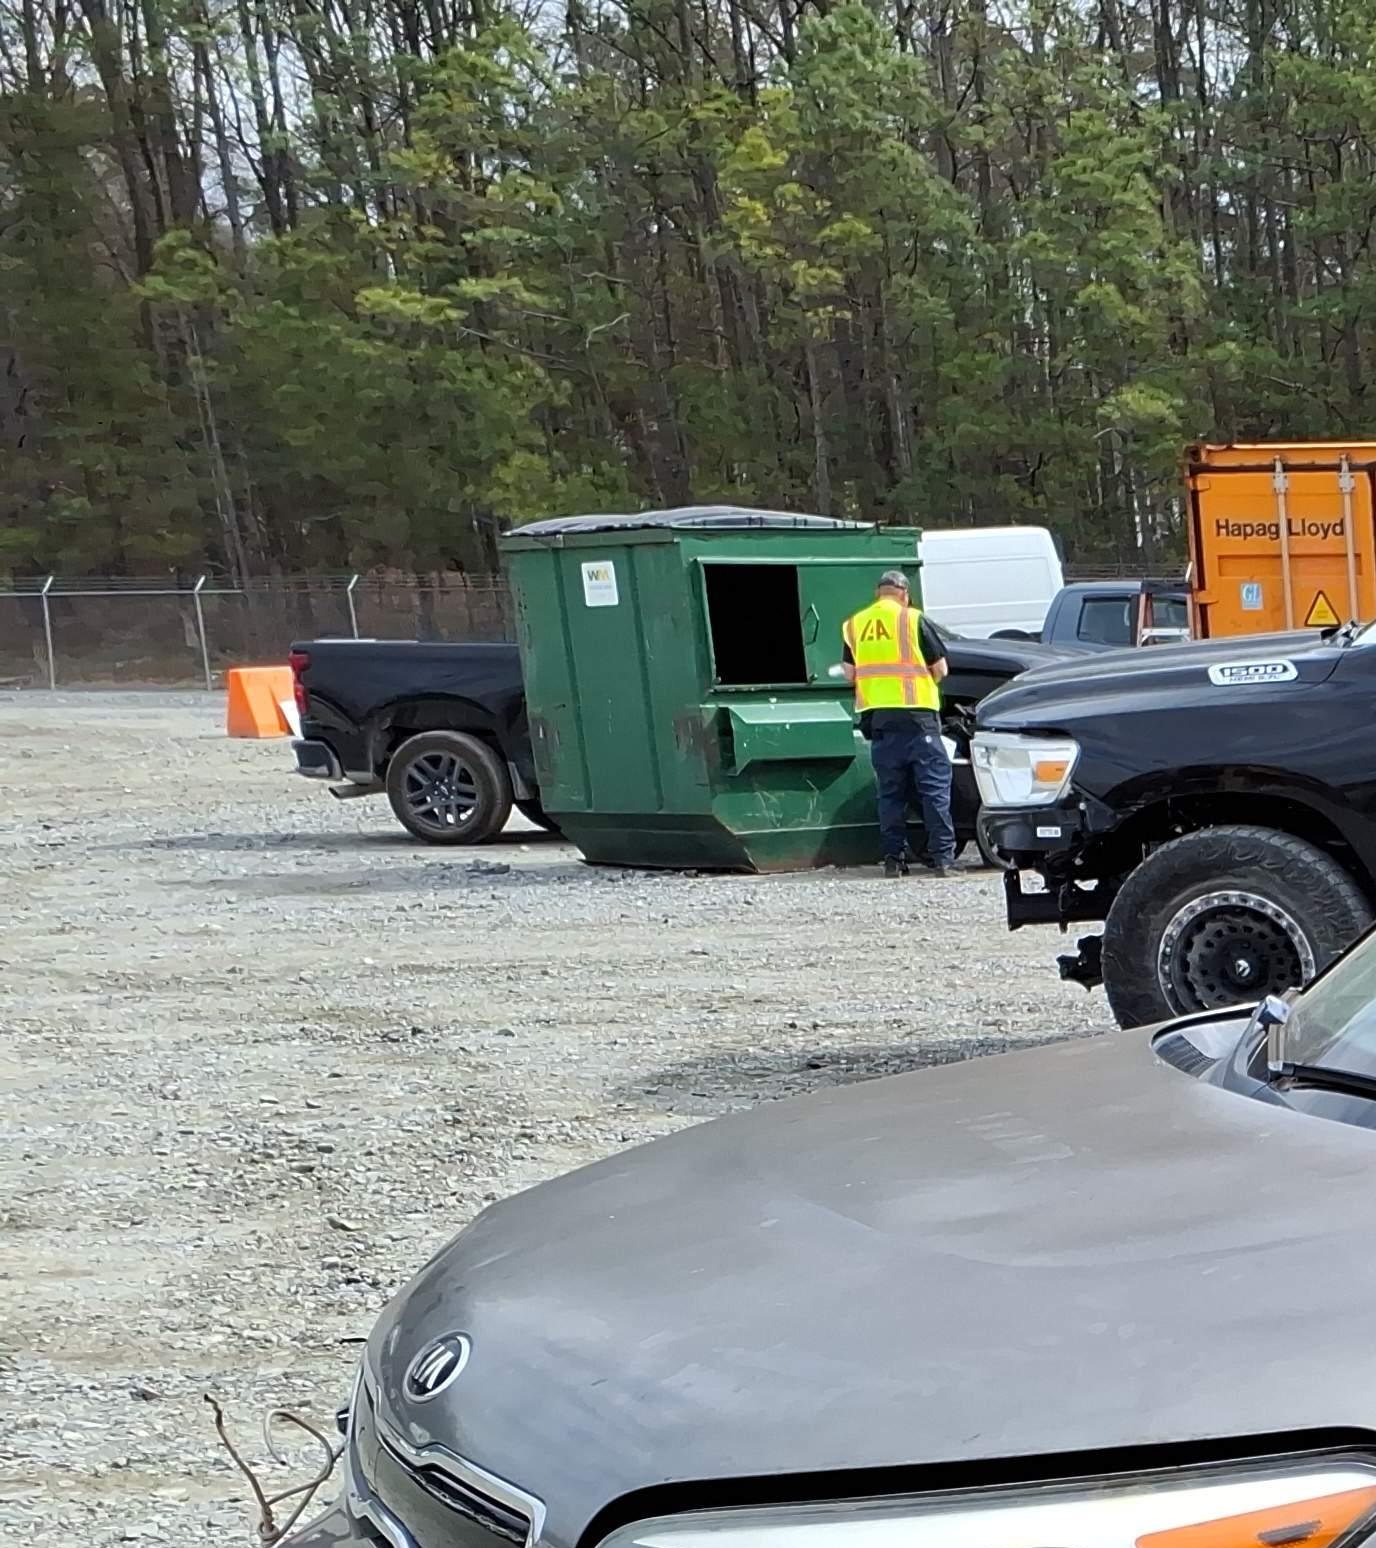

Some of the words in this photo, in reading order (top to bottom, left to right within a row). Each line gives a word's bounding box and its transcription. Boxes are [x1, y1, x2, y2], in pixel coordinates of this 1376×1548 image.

[1215, 518, 1280, 540] Hapag
[1288, 518, 1345, 540] Lloyd
[1223, 664, 1284, 677] 1500
